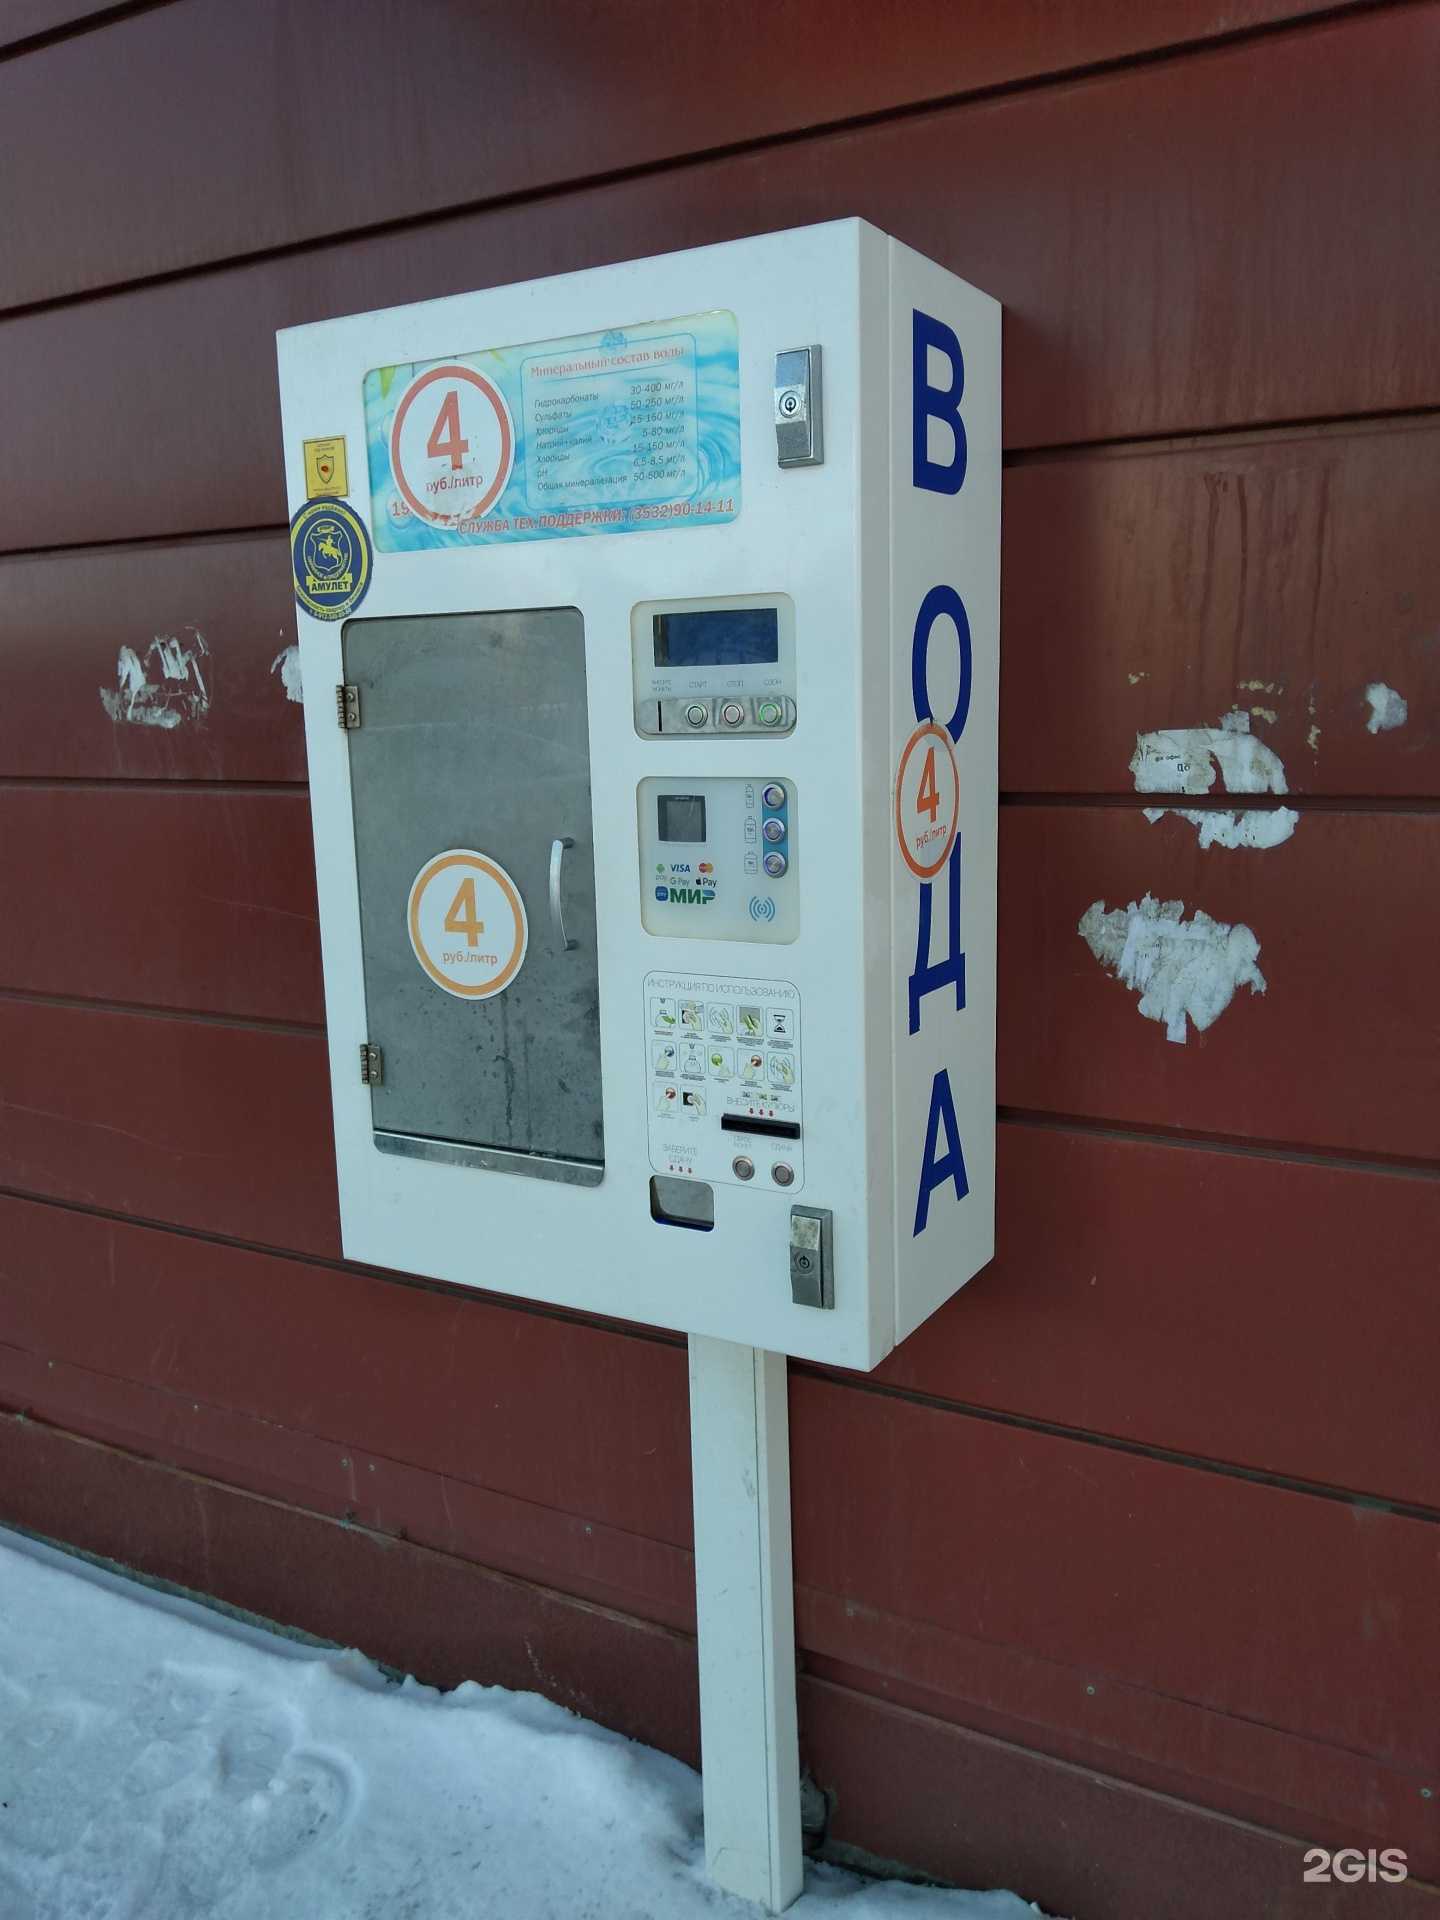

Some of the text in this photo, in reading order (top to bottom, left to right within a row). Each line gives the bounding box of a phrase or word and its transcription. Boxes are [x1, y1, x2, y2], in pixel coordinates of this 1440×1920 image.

[611, 350, 650, 365] состав
[426, 390, 470, 471] 4
[459, 516, 510, 534] СЛУЖБА
[311, 580, 349, 592] АМУЛЕТ
[912, 308, 972, 1238] ВОДА
[917, 746, 940, 823] 4
[670, 863, 691, 872] VISA
[702, 877, 718, 889] Pay
[669, 888, 716, 904] МИР
[444, 877, 485, 947] 4
[442, 950, 498, 966] руб./литр
